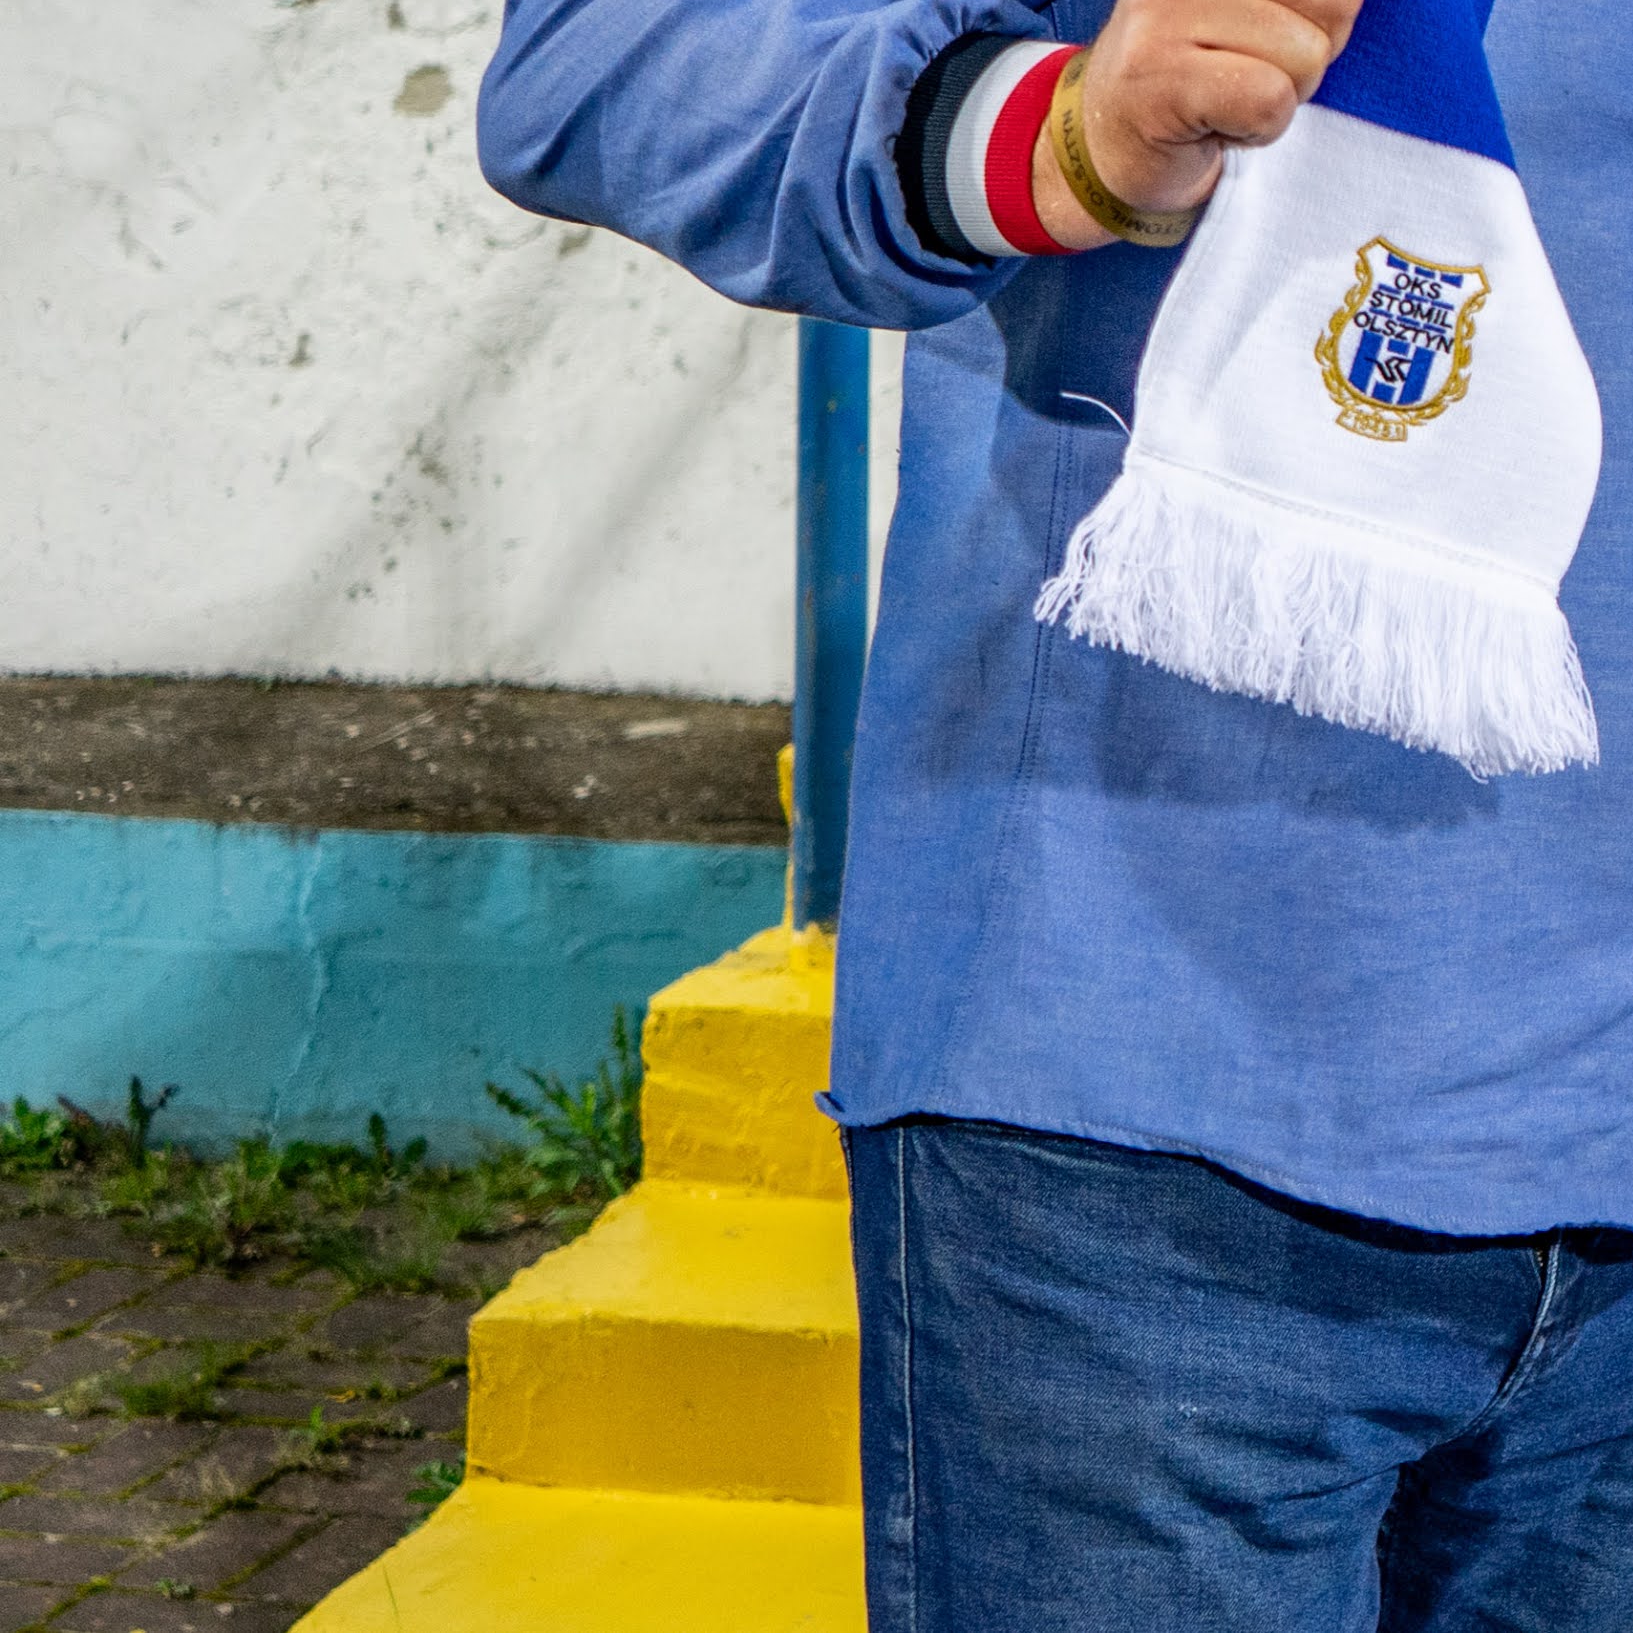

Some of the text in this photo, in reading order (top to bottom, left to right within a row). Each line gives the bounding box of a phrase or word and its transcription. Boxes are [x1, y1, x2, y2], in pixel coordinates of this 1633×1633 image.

[1394, 272, 1443, 301] OKS
[1369, 290, 1454, 330] STOMIL
[1353, 311, 1455, 354] OLSZTYN
